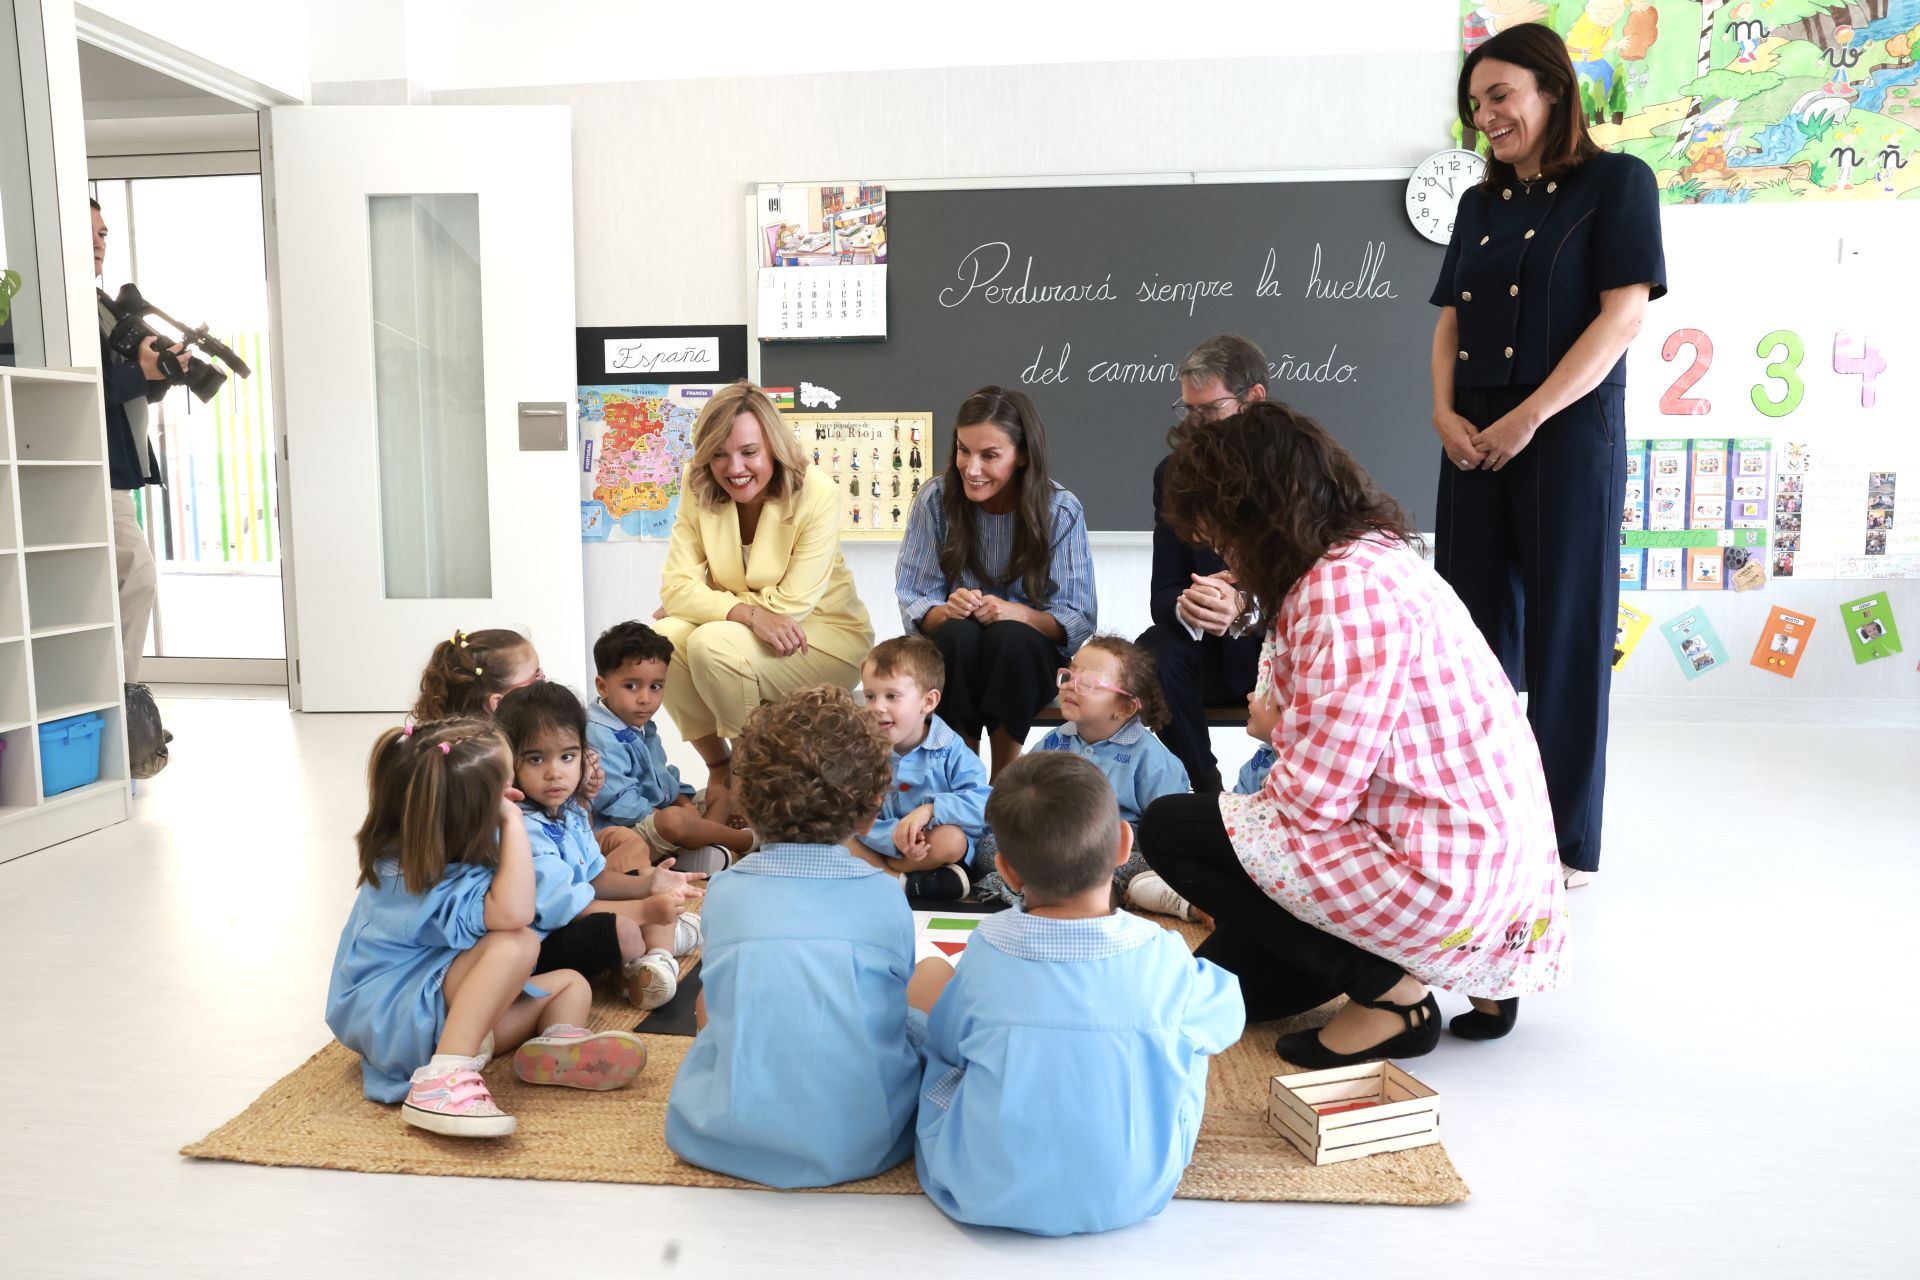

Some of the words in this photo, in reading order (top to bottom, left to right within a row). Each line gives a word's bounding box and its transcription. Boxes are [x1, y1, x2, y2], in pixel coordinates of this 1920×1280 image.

[1725, 19, 1770, 41] m
[1830, 147, 1864, 168] n
[1879, 144, 1908, 169] ñ
[1434, 165, 1444, 175] 11
[1448, 161, 1461, 171] 12
[1467, 165, 1472, 175] 1
[1423, 177, 1437, 187] 10
[1418, 192, 1426, 202] 9
[1421, 208, 1430, 218] 8
[1432, 218, 1439, 229] 7
[1447, 223, 1454, 232] 6
[939, 241, 1117, 308] Perdurará
[1136, 273, 1234, 317] siempre
[1256, 247, 1282, 297] la
[1305, 240, 1399, 300] huella
[613, 343, 711, 373] España
[1021, 343, 1070, 384] del
[1088, 354, 1179, 383] camin
[1268, 344, 1358, 384] eñado.
[1659, 328, 1714, 415] 2
[1751, 329, 1805, 417] 3
[1832, 329, 1887, 409] 4
[827, 428, 842, 438] La
[848, 428, 882, 440] Rioja
[653, 519, 668, 529] MAR
[1631, 530, 1708, 548] RECREO
